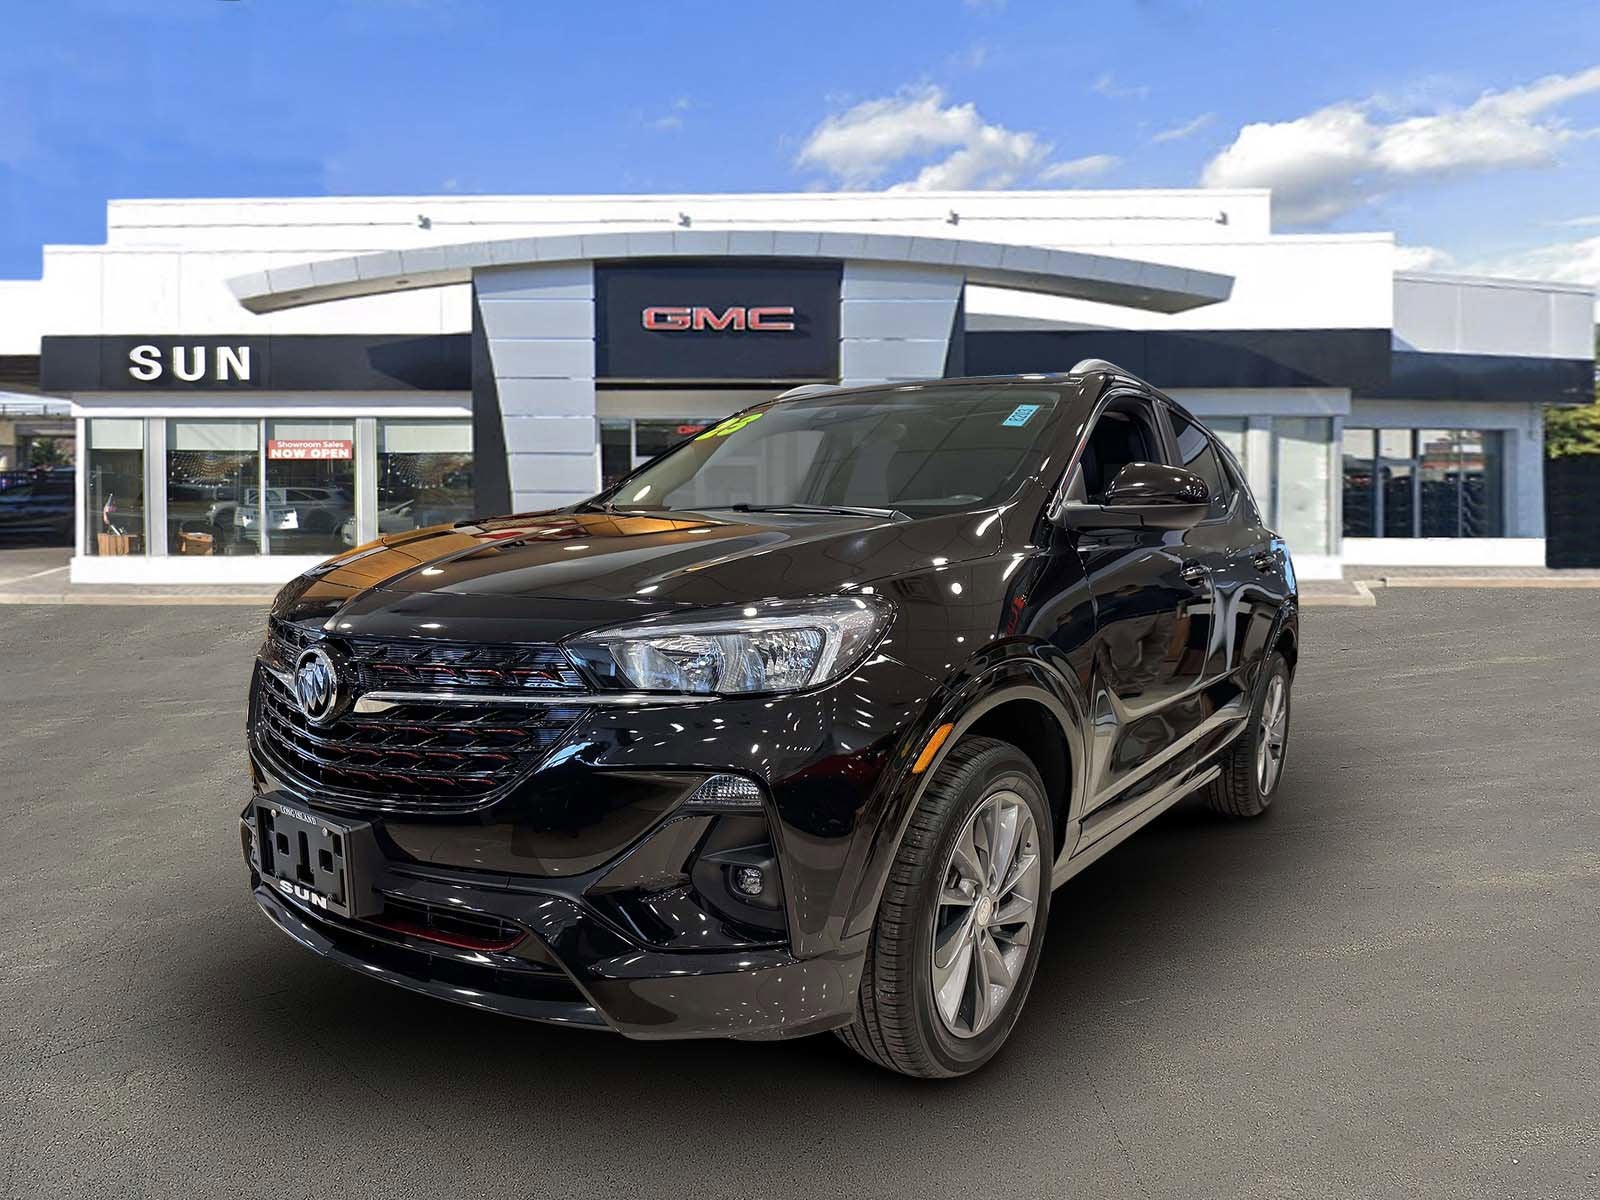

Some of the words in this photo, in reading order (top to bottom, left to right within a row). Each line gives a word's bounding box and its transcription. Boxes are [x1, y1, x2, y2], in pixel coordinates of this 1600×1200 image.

[642, 306, 795, 330] GMC
[128, 344, 251, 381] SUN
[271, 449, 306, 458] NOW
[311, 449, 349, 458] OPEN
[280, 880, 327, 909] SUN
